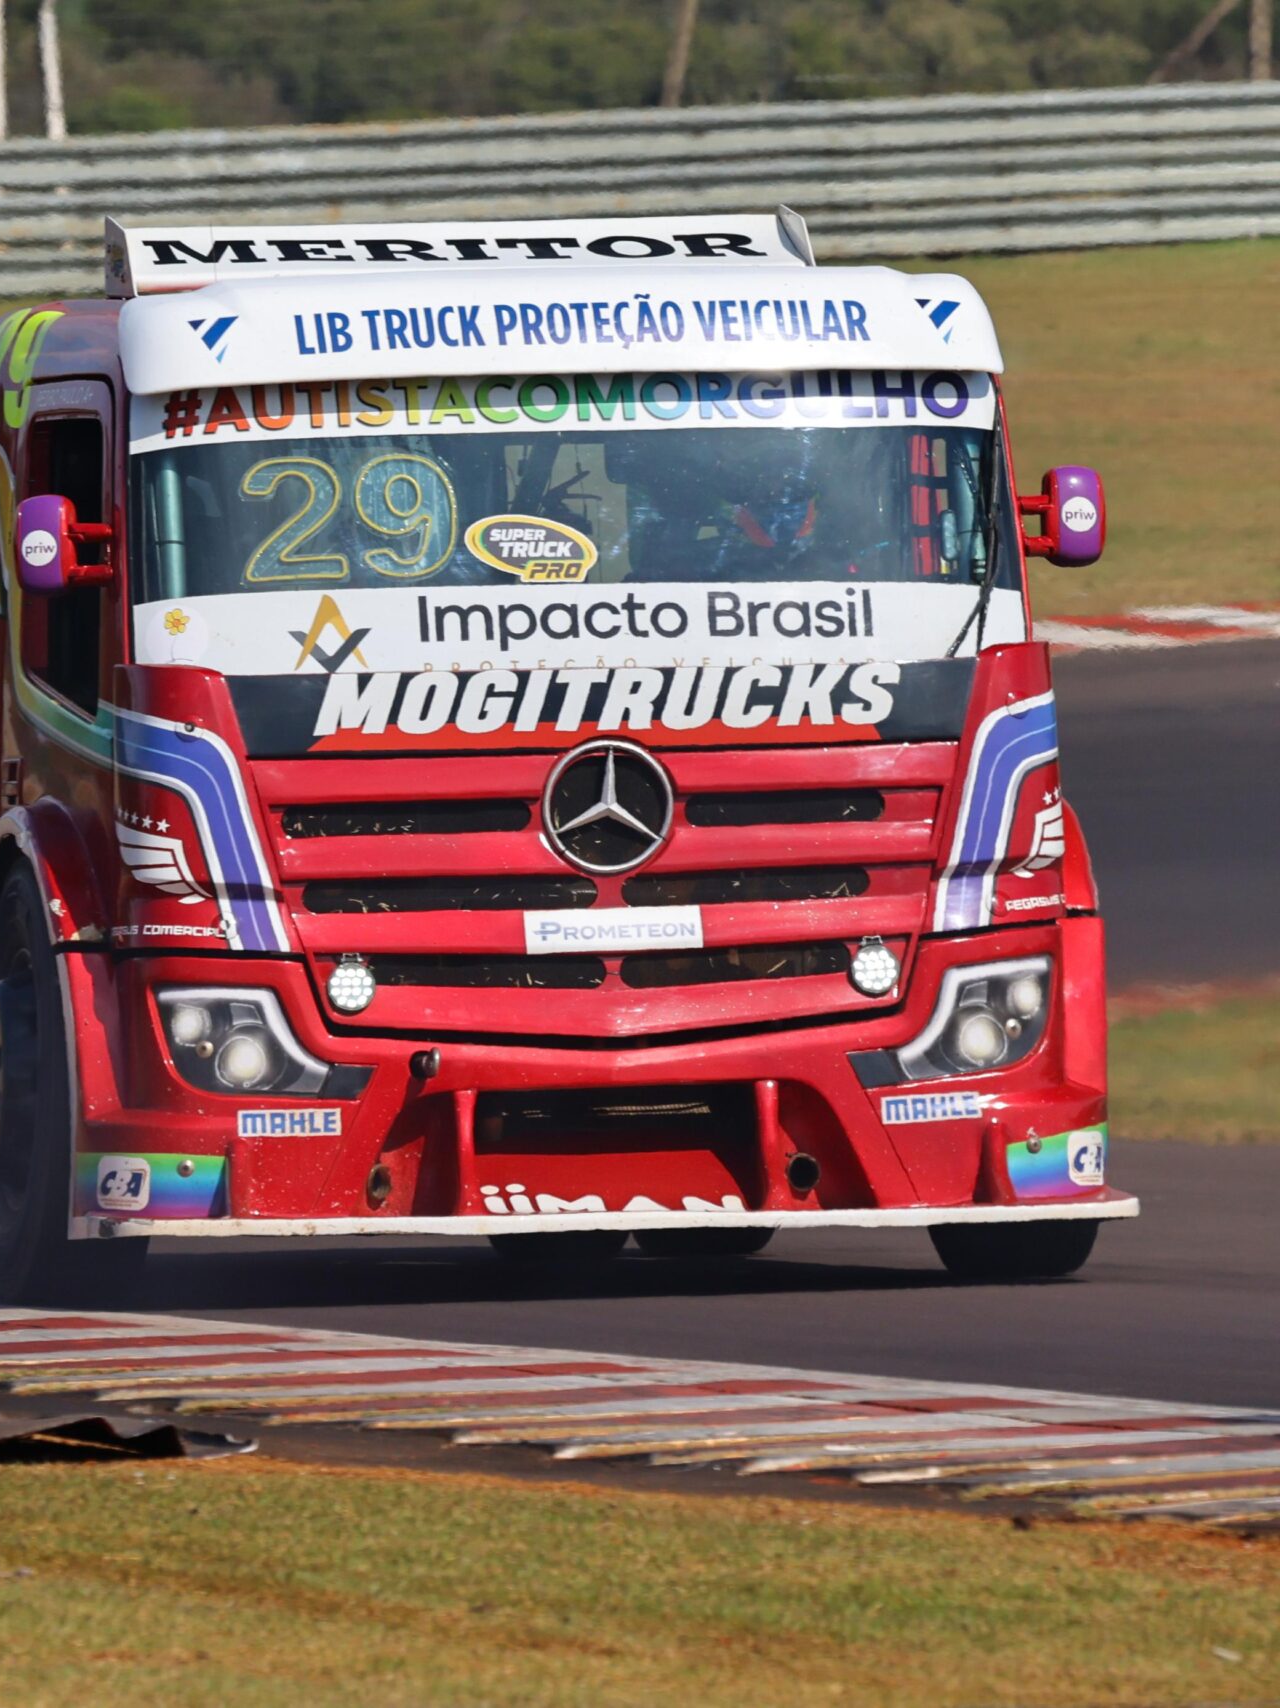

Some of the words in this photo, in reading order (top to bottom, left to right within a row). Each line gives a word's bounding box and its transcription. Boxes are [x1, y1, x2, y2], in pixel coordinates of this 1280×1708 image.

[142, 234, 769, 266] MERITOR
[293, 312, 354, 355] LIB
[360, 305, 483, 351] TRUCK
[496, 294, 685, 350] PROTEÇÃO
[696, 299, 871, 344] VEICULAR
[162, 371, 970, 439] #AUTISTACOMORGULHO
[241, 453, 458, 584] 29
[1064, 508, 1095, 523] priw
[489, 528, 547, 541] SUPER
[25, 541, 56, 558] priw
[499, 541, 574, 558] TRUCK
[528, 562, 583, 579] PRO
[417, 594, 689, 652] Impacto
[706, 587, 875, 638] Brasil
[312, 661, 902, 737] MOGITRUCKS
[534, 921, 697, 942] PROMETEON
[885, 1095, 979, 1121] MAHLE
[241, 1111, 337, 1134] MAHLE
